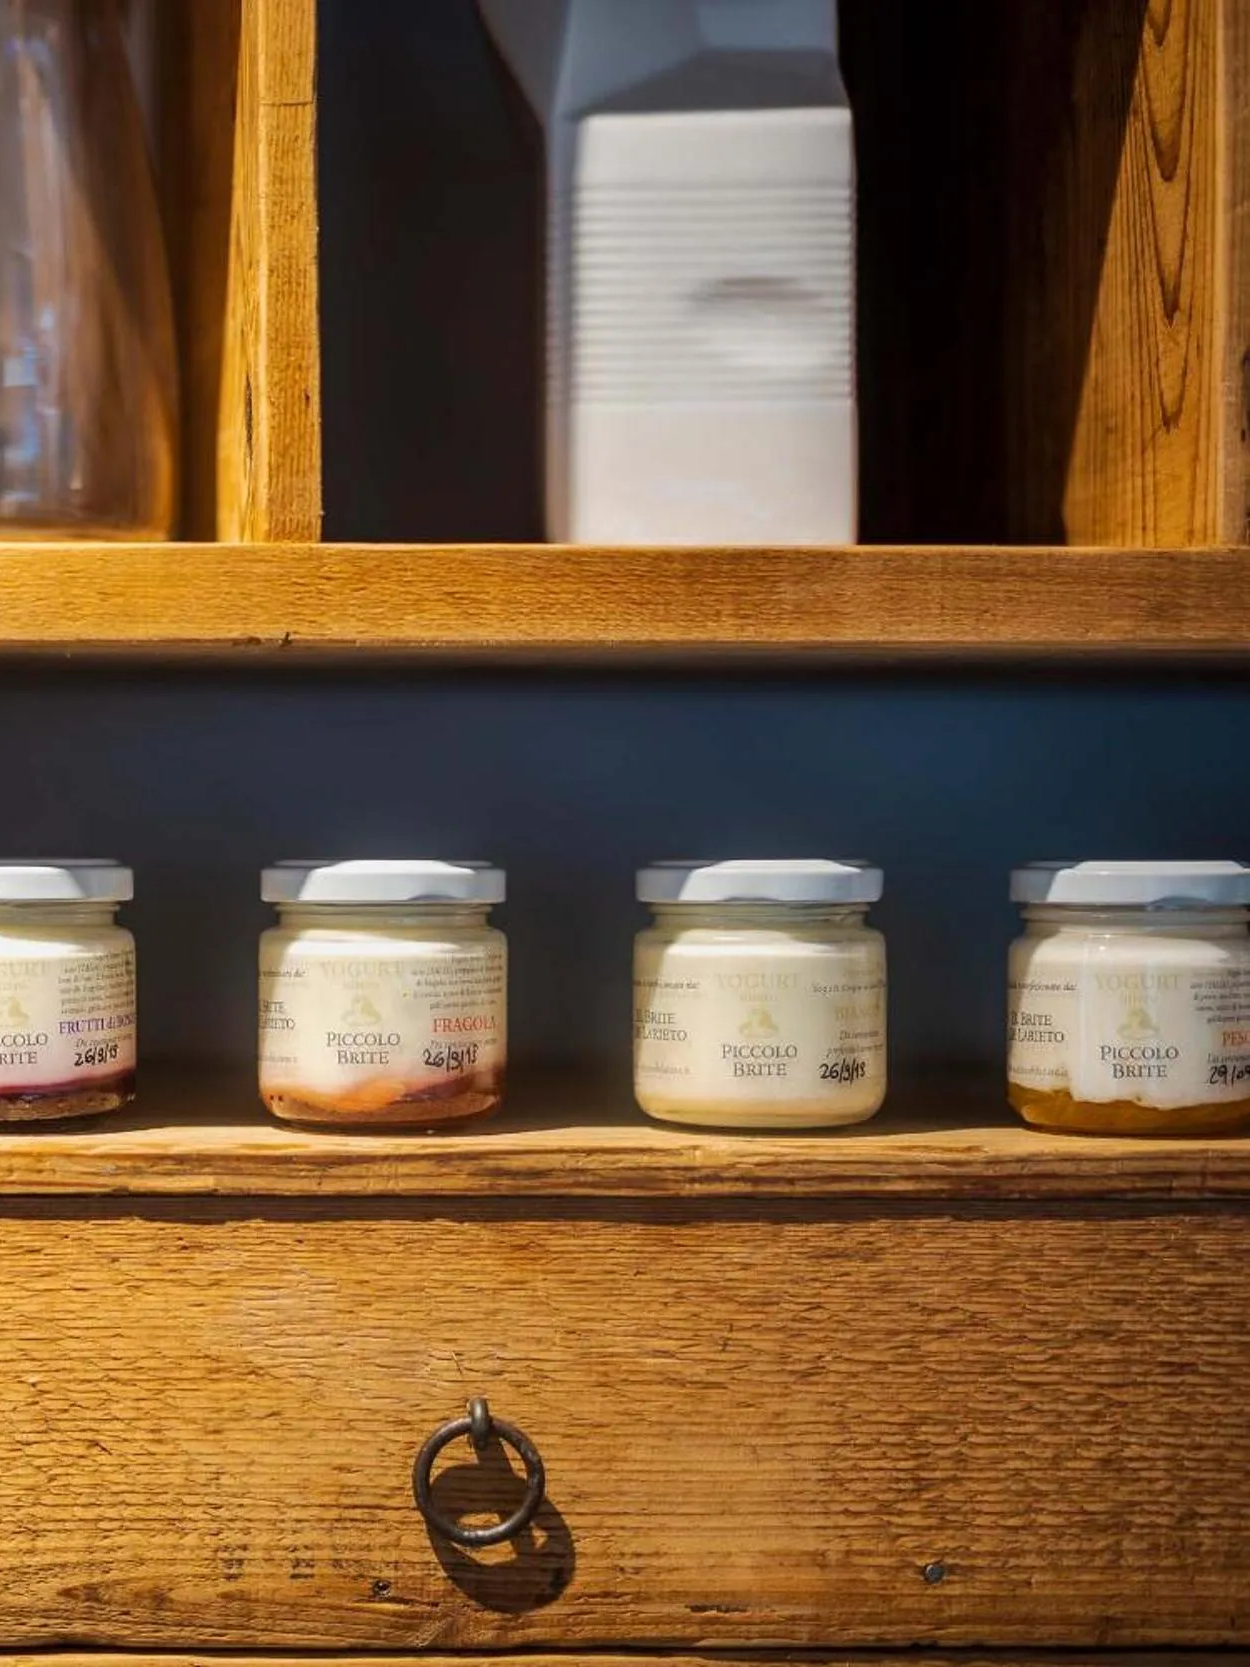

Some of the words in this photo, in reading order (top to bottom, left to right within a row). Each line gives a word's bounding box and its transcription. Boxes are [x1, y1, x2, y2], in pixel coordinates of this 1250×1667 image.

[58, 1018, 105, 1035] FRUTTI
[433, 1015, 496, 1034] FRAGOLA
[327, 1032, 401, 1047] PICCOLO
[336, 1050, 390, 1066] BRITE
[722, 1044, 798, 1060] PICCOLO
[1100, 1045, 1179, 1061] PICCOLO
[733, 1062, 788, 1078] BRITE
[1112, 1063, 1168, 1079] BRITE
